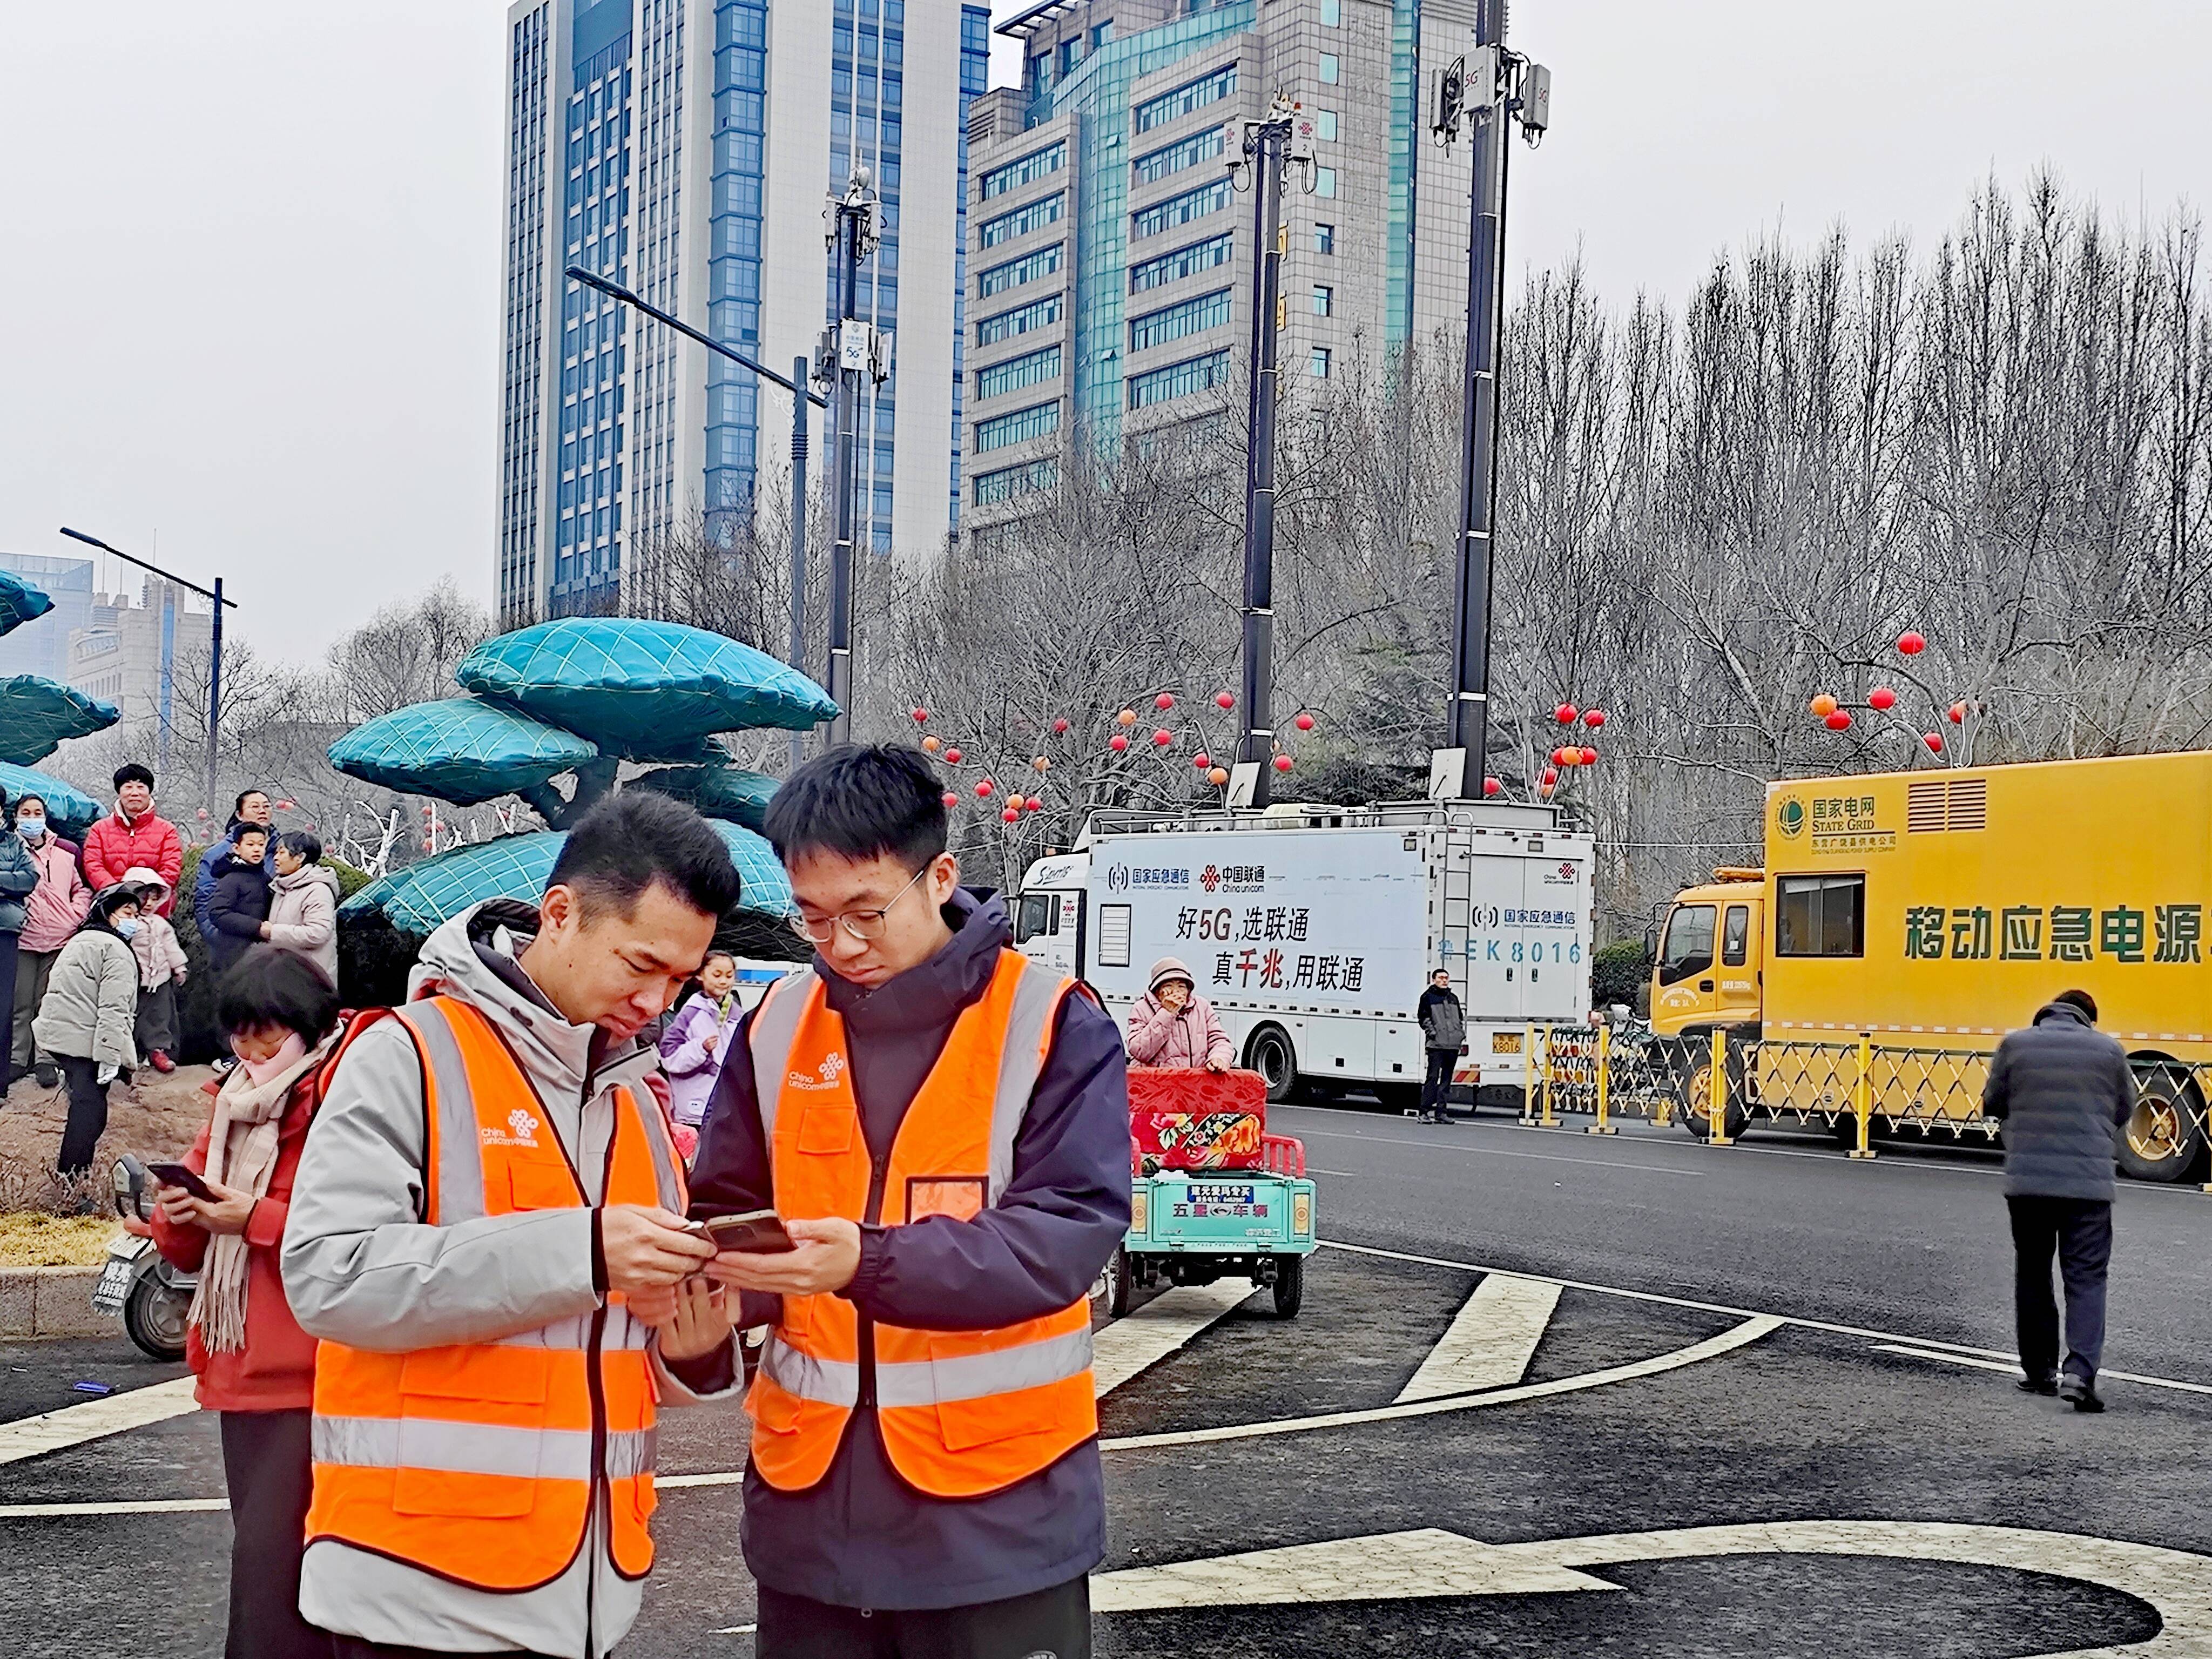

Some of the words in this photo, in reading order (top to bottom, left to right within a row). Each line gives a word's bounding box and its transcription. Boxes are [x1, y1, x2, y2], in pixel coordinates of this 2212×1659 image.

[846, 346, 860, 358] 5G
[1813, 797, 1875, 818] 国家电网
[1812, 820, 1844, 832] STATE
[1847, 818, 1875, 831] GRID
[1133, 868, 1189, 884] 国家应急通信
[1223, 866, 1264, 882] 中国联通
[1176, 906, 1310, 942] 好5G，选联通
[1505, 909, 1575, 924] 国家应急通信
[1905, 905, 2212, 964] 移动应急电源
[1212, 948, 1365, 992] 真千兆，用联通
[1493, 1041, 1520, 1053] K8016
[788, 1071, 814, 1083] China
[481, 1127, 506, 1137] China
